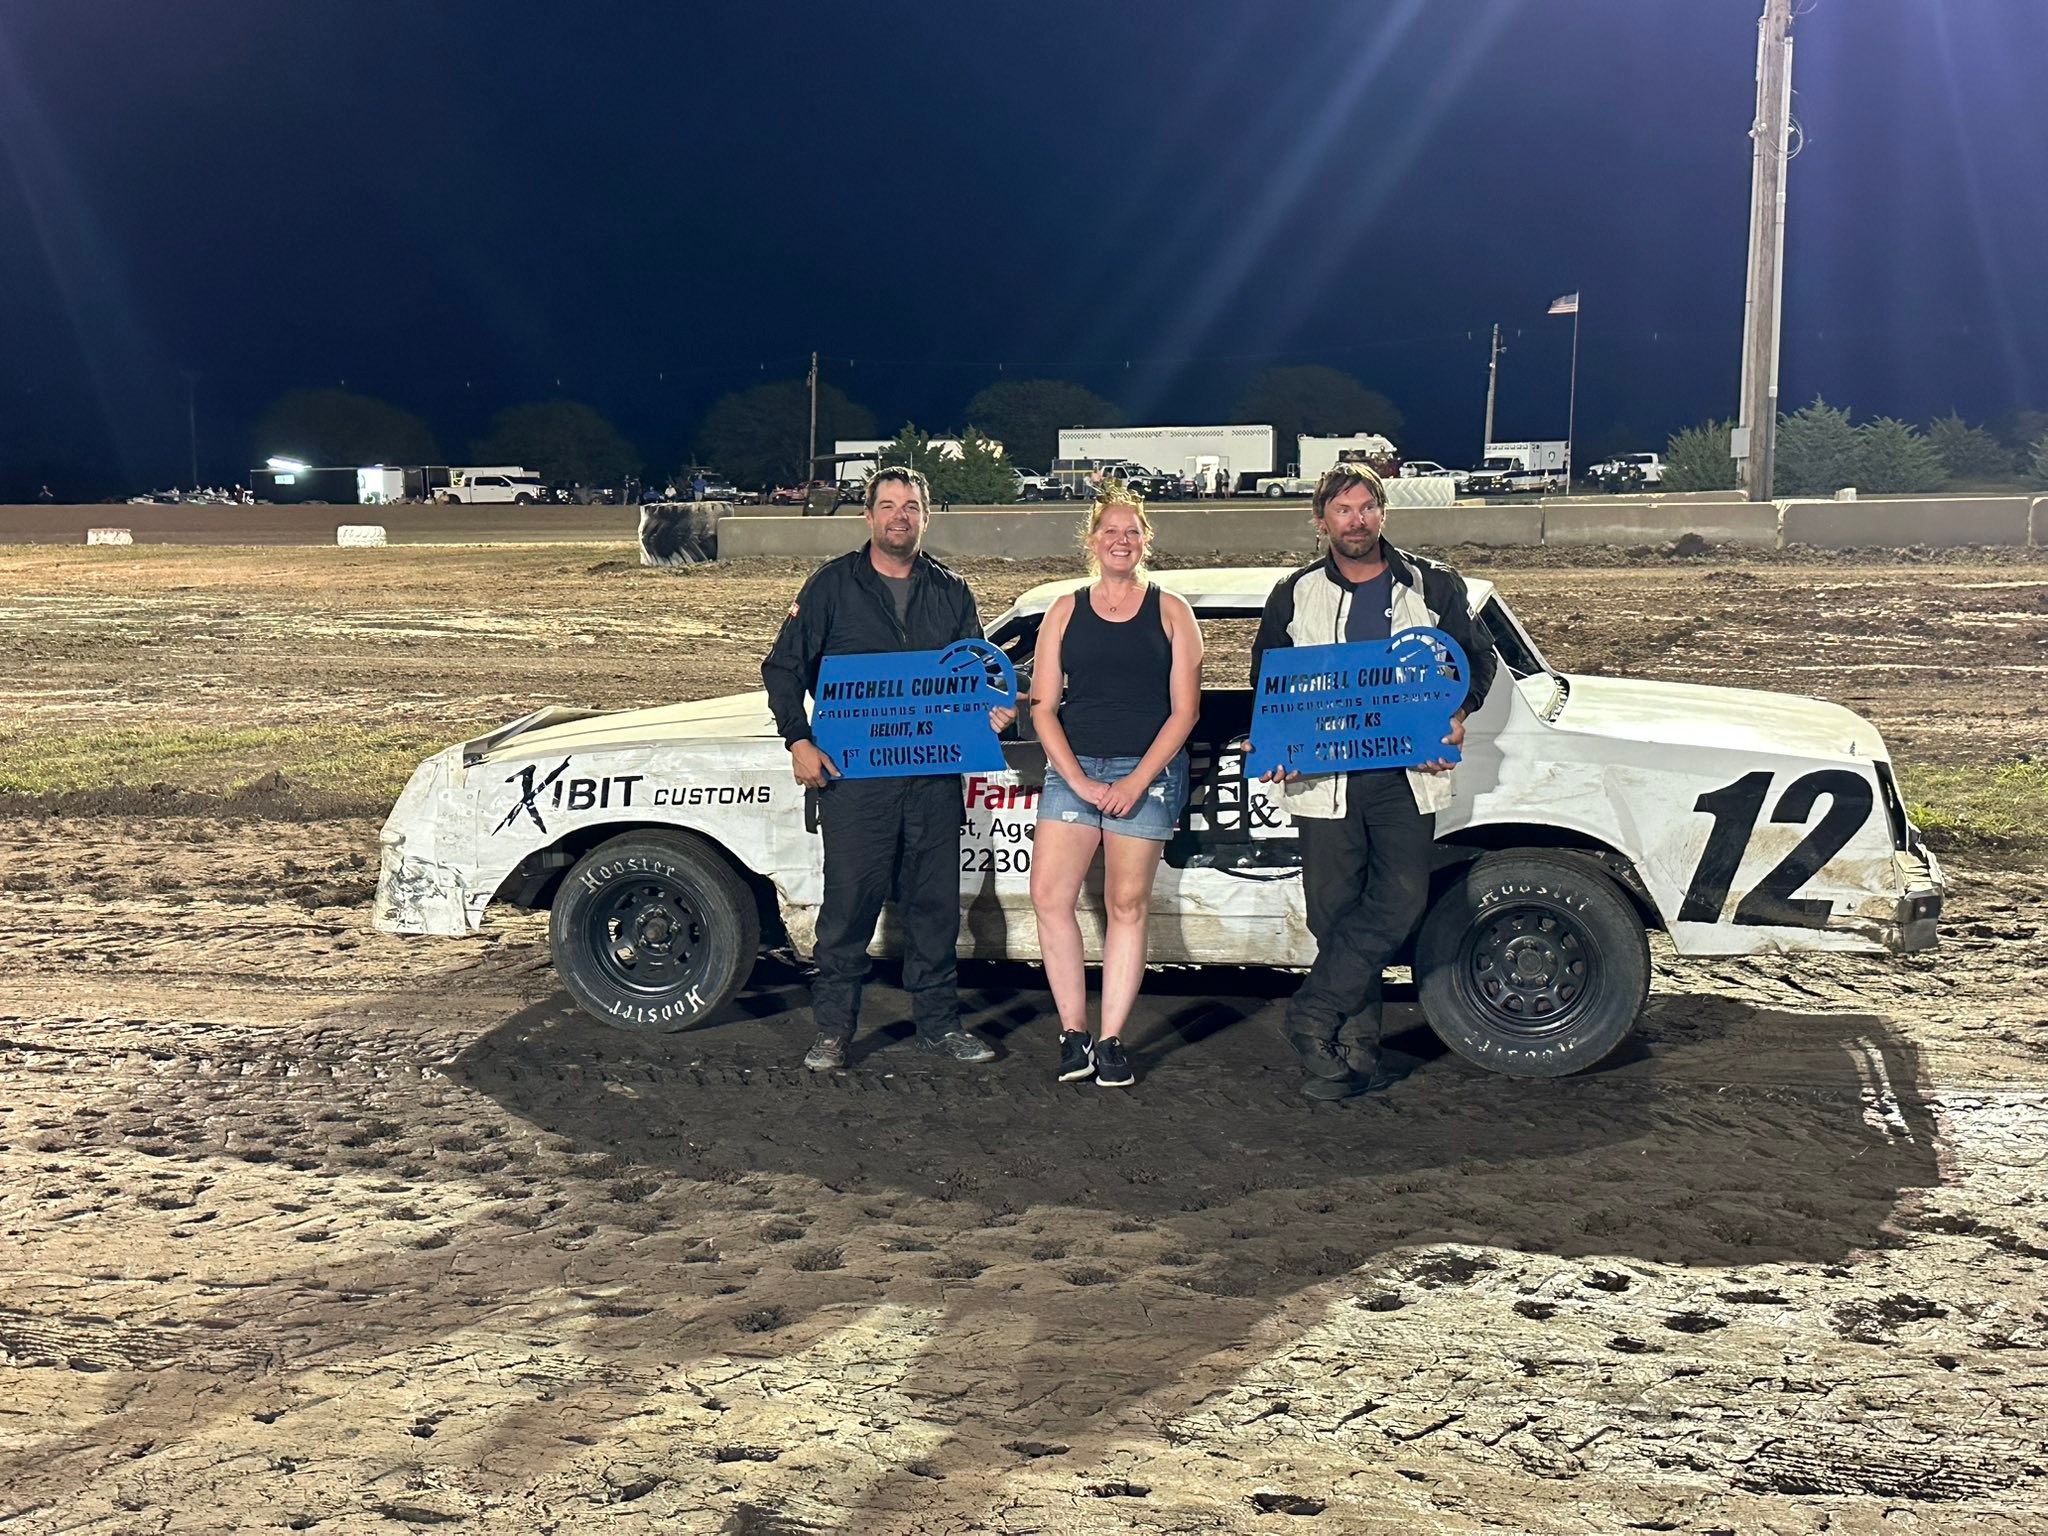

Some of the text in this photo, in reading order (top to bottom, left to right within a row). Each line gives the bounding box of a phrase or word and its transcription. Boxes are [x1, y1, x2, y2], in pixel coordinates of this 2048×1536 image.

[822, 675, 980, 700] MITCHELL COUNTY
[1264, 665, 1429, 695] MITCHELL COUNTY
[917, 720, 933, 735] KS
[1364, 712, 1381, 727] KS
[842, 744, 962, 768] 1ST CRUISERS
[1286, 735, 1413, 764] 1ST CRUISERS
[654, 786, 771, 806] CUSTOMS
[961, 848, 1031, 873] 2230
[1677, 769, 1874, 928] 12
